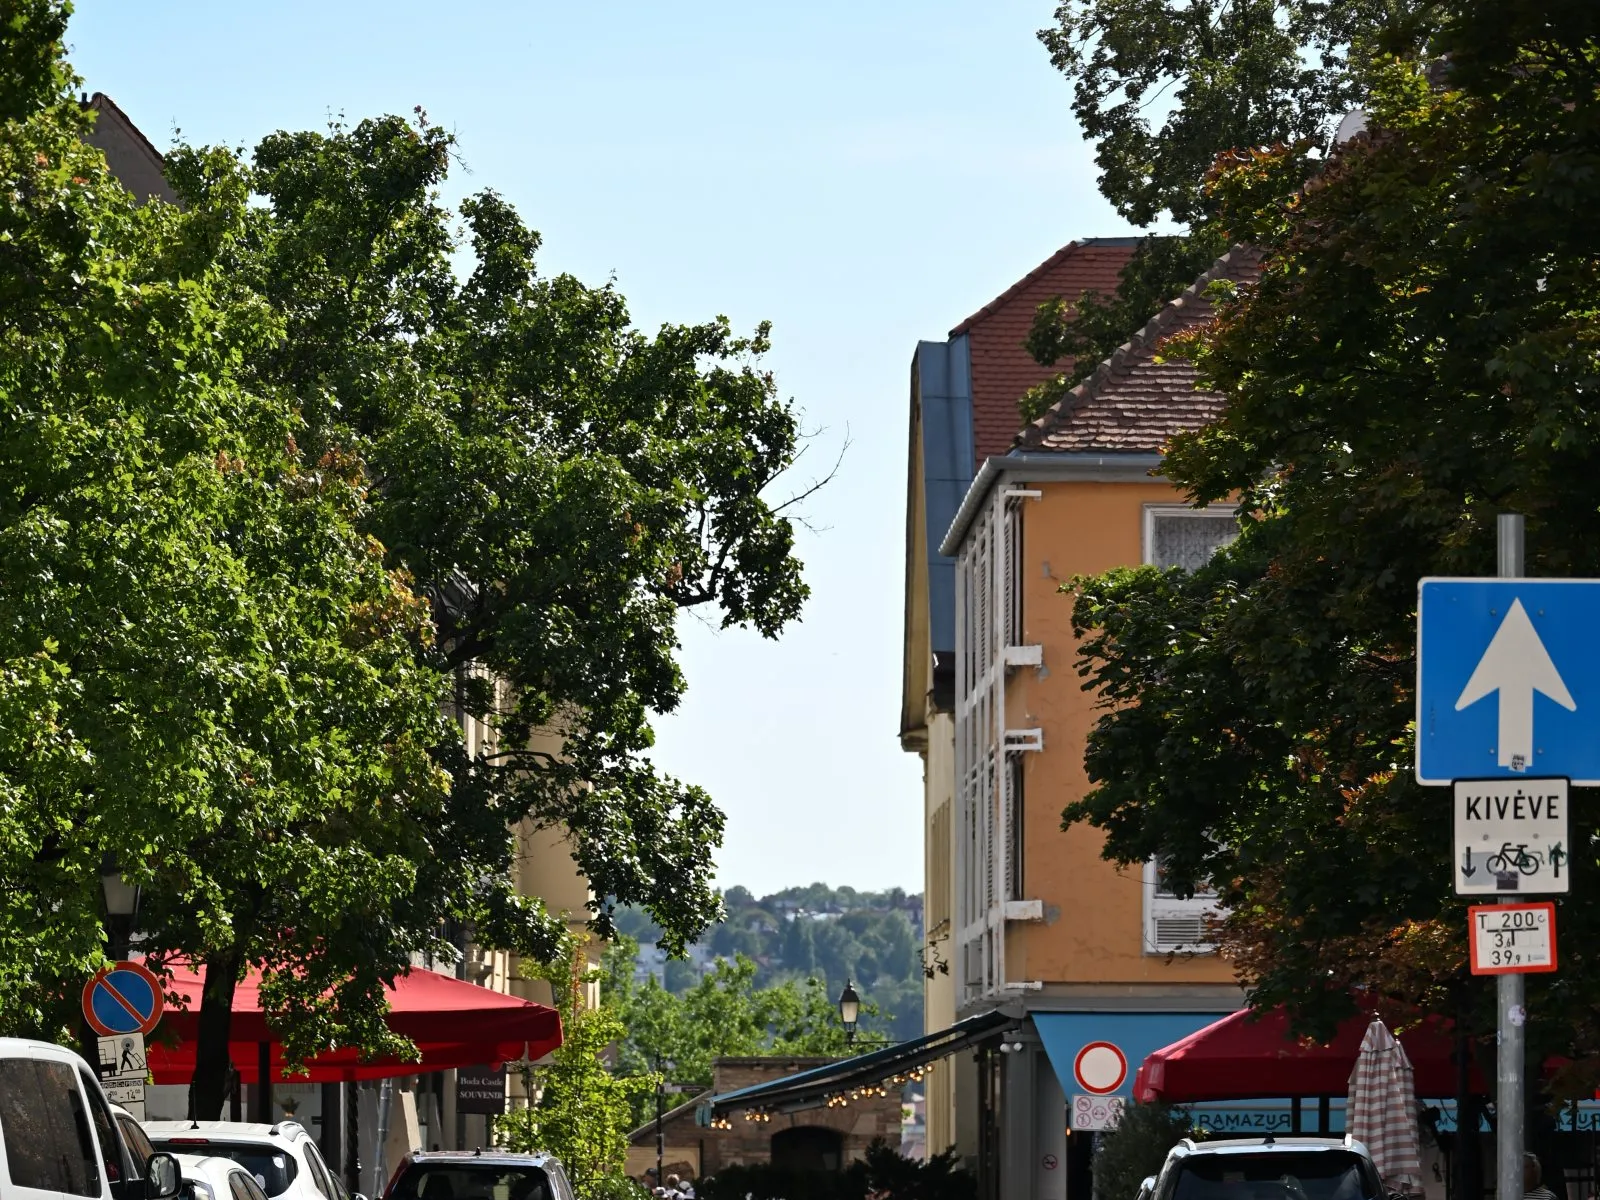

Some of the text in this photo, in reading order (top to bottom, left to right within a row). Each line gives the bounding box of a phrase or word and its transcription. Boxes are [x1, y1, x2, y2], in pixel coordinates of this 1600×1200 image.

[1478, 914, 1488, 929] T
[1501, 911, 1534, 929] 200
[460, 1076, 503, 1086] Buda Castle
[459, 1090, 503, 1099] SOUVENIR
